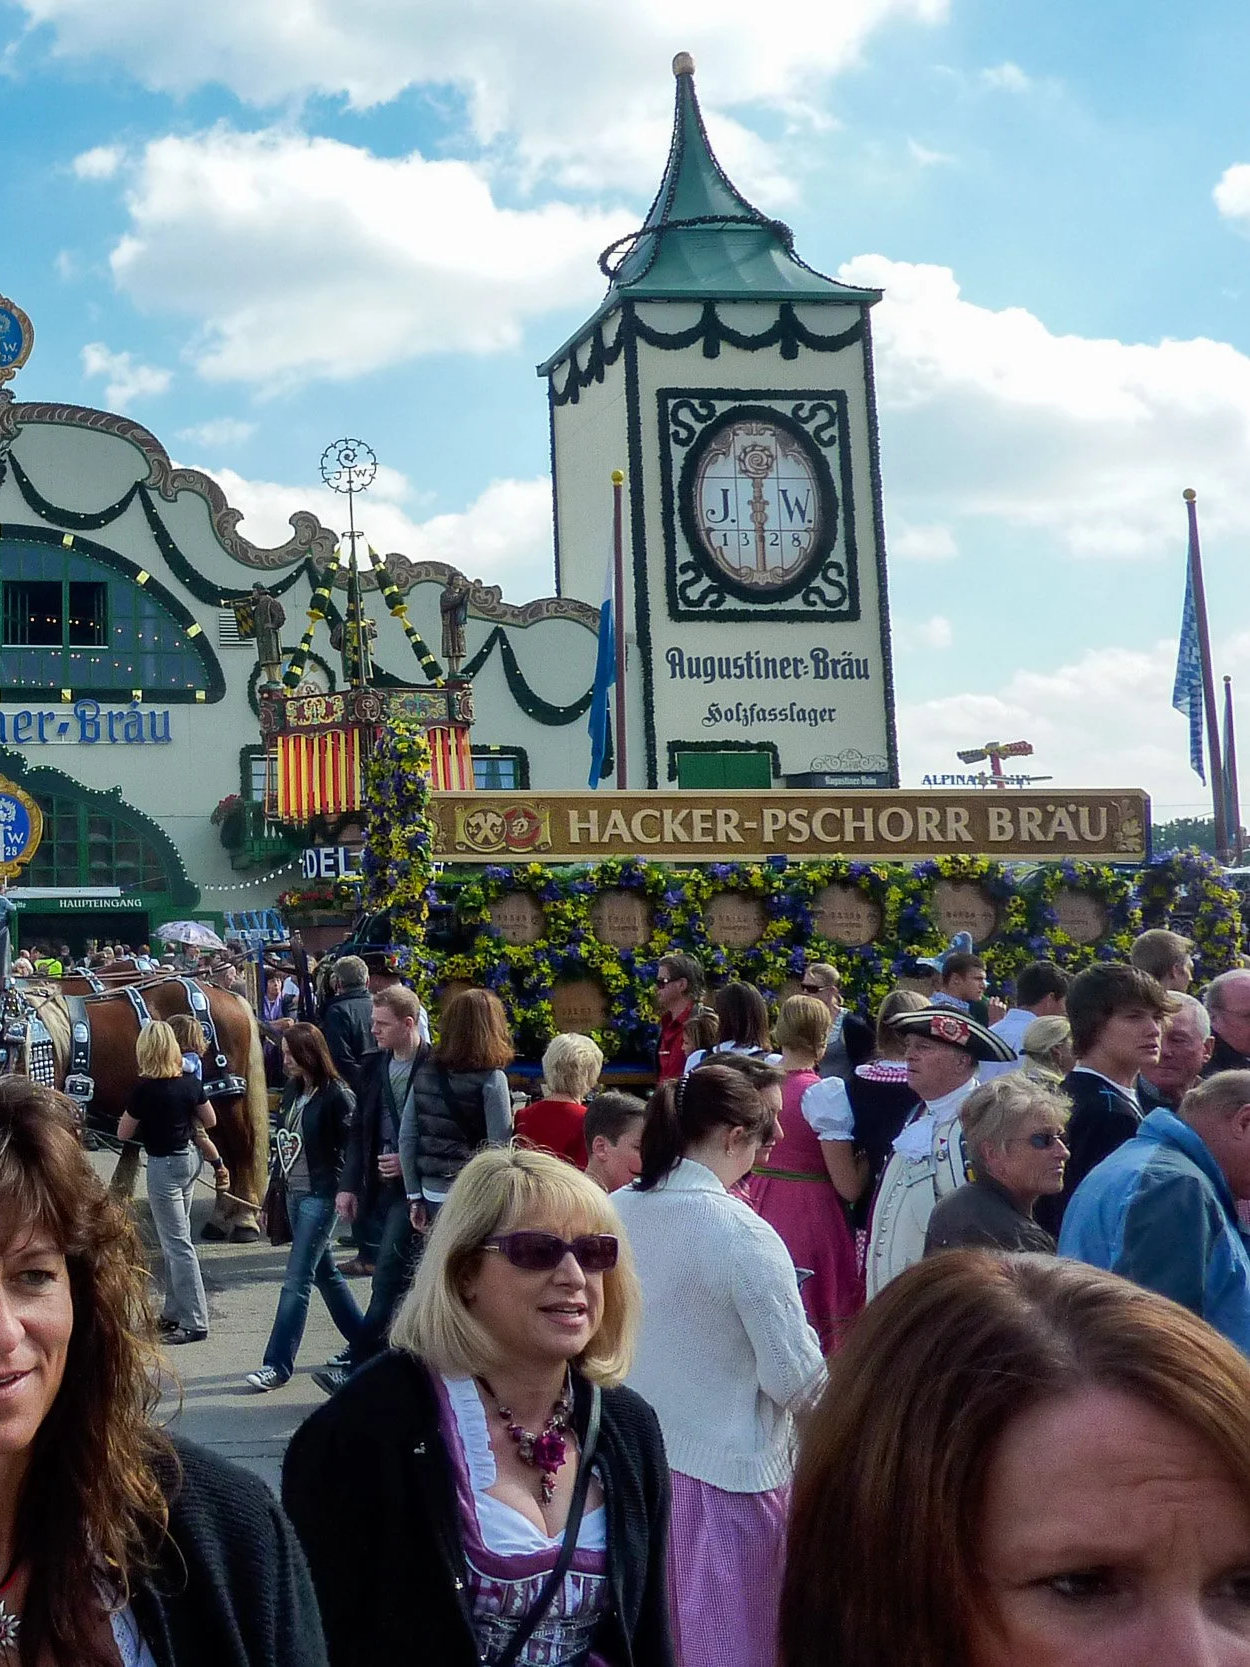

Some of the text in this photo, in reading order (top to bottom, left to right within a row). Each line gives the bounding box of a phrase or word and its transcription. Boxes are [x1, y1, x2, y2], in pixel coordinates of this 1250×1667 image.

[567, 803, 1108, 844] HACKER-PSCHORR BRÄU
[5, 846, 18, 857] 28
[58, 898, 143, 908] HAUPTEINGANG
